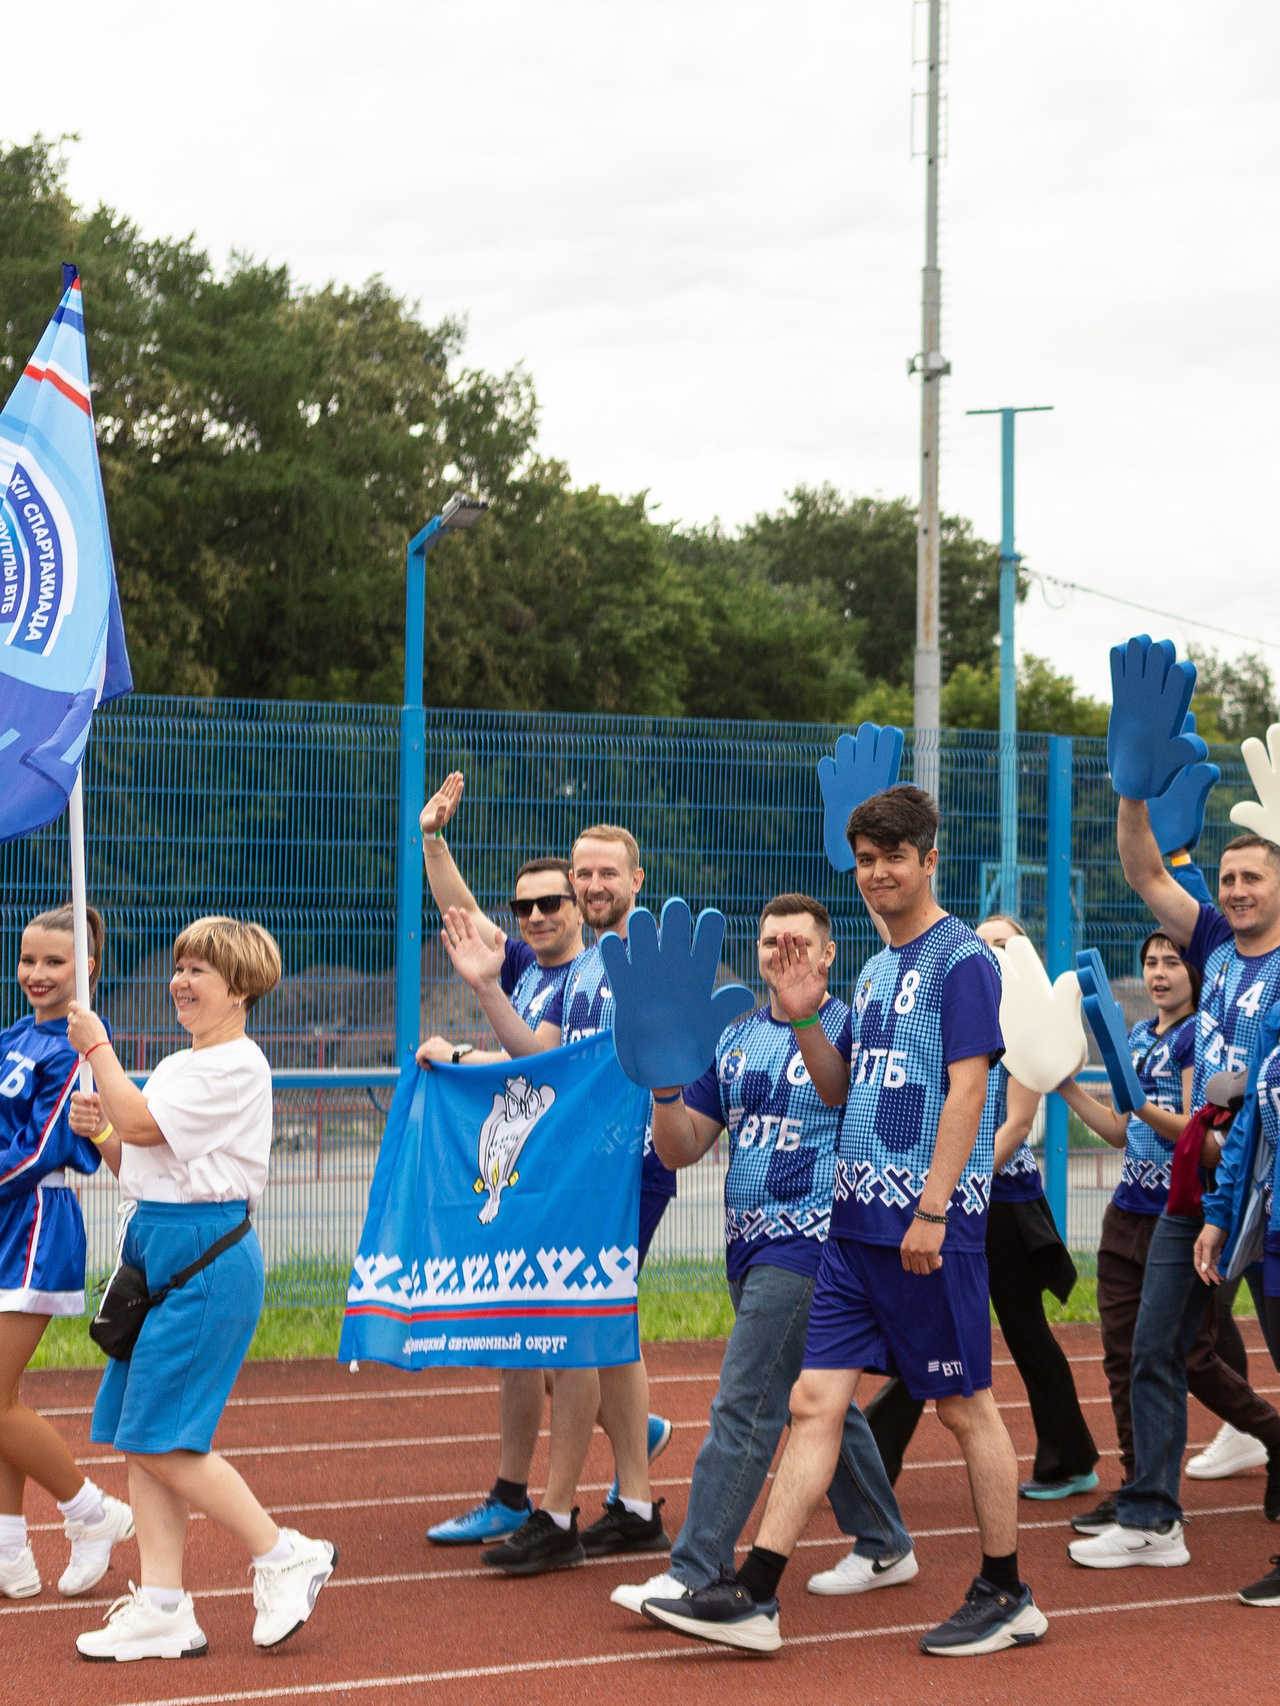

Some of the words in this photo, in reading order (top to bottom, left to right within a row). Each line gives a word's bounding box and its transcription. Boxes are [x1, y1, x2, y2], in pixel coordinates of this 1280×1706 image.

[23, 503, 56, 641] СПАРТАКИАДА
[1, 582, 18, 614] ВТБ
[528, 985, 555, 1018] 4
[894, 969, 921, 1015] 8
[1236, 980, 1266, 1018] 4
[786, 1050, 811, 1086] 6
[1151, 1043, 1173, 1077] 2
[739, 1114, 804, 1152] ВТБ
[448, 1332, 522, 1351] автономный
[525, 1335, 567, 1354] округ
[941, 1361, 963, 1377] ВТ
